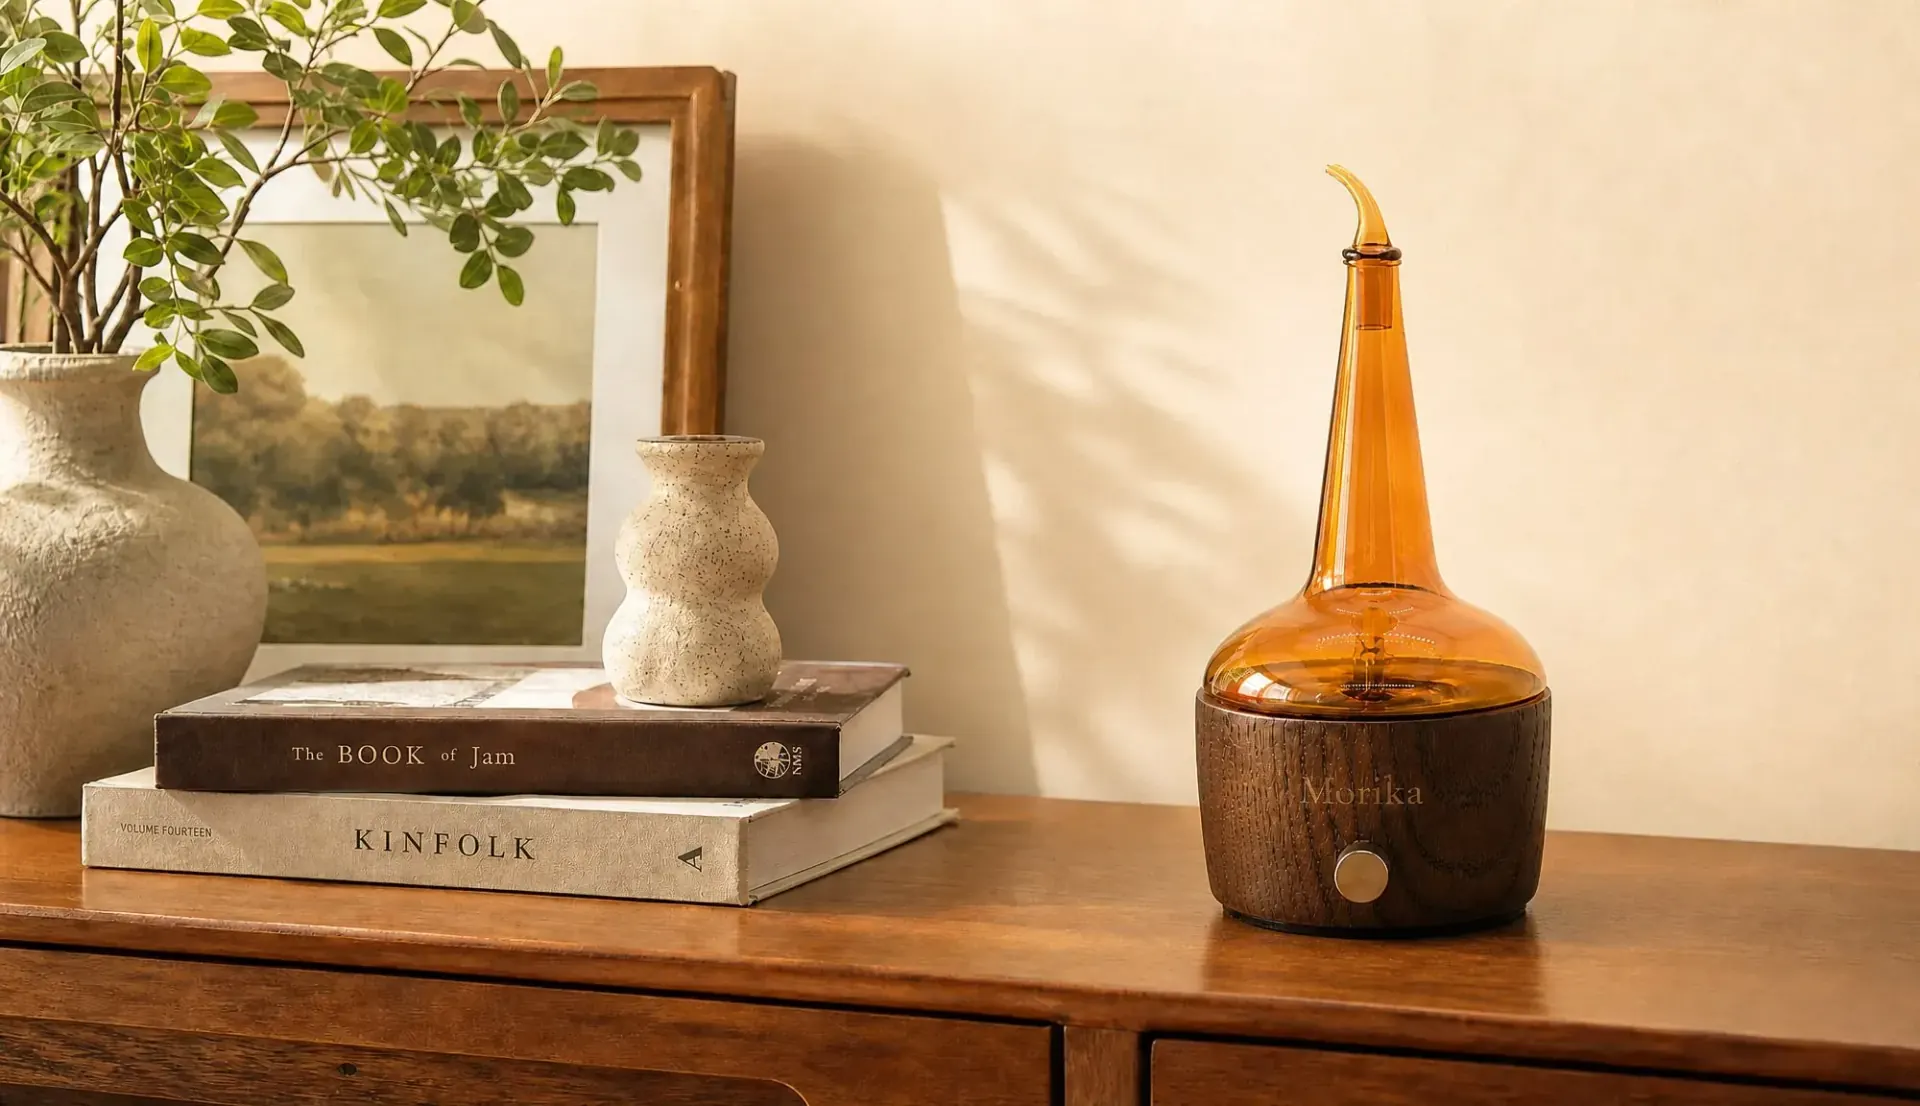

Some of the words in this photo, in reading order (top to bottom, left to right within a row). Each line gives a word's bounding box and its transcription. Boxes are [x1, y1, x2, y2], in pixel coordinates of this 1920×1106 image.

[292, 747, 324, 760] The
[338, 745, 425, 765] BOOK
[441, 748, 457, 761] of
[470, 747, 516, 769] Jam
[792, 746, 802, 775] NMS
[1301, 775, 1424, 805] Morika
[120, 823, 160, 834] VOLUME
[162, 826, 212, 837] FOURTEEN
[354, 829, 535, 860] KINFOLK
